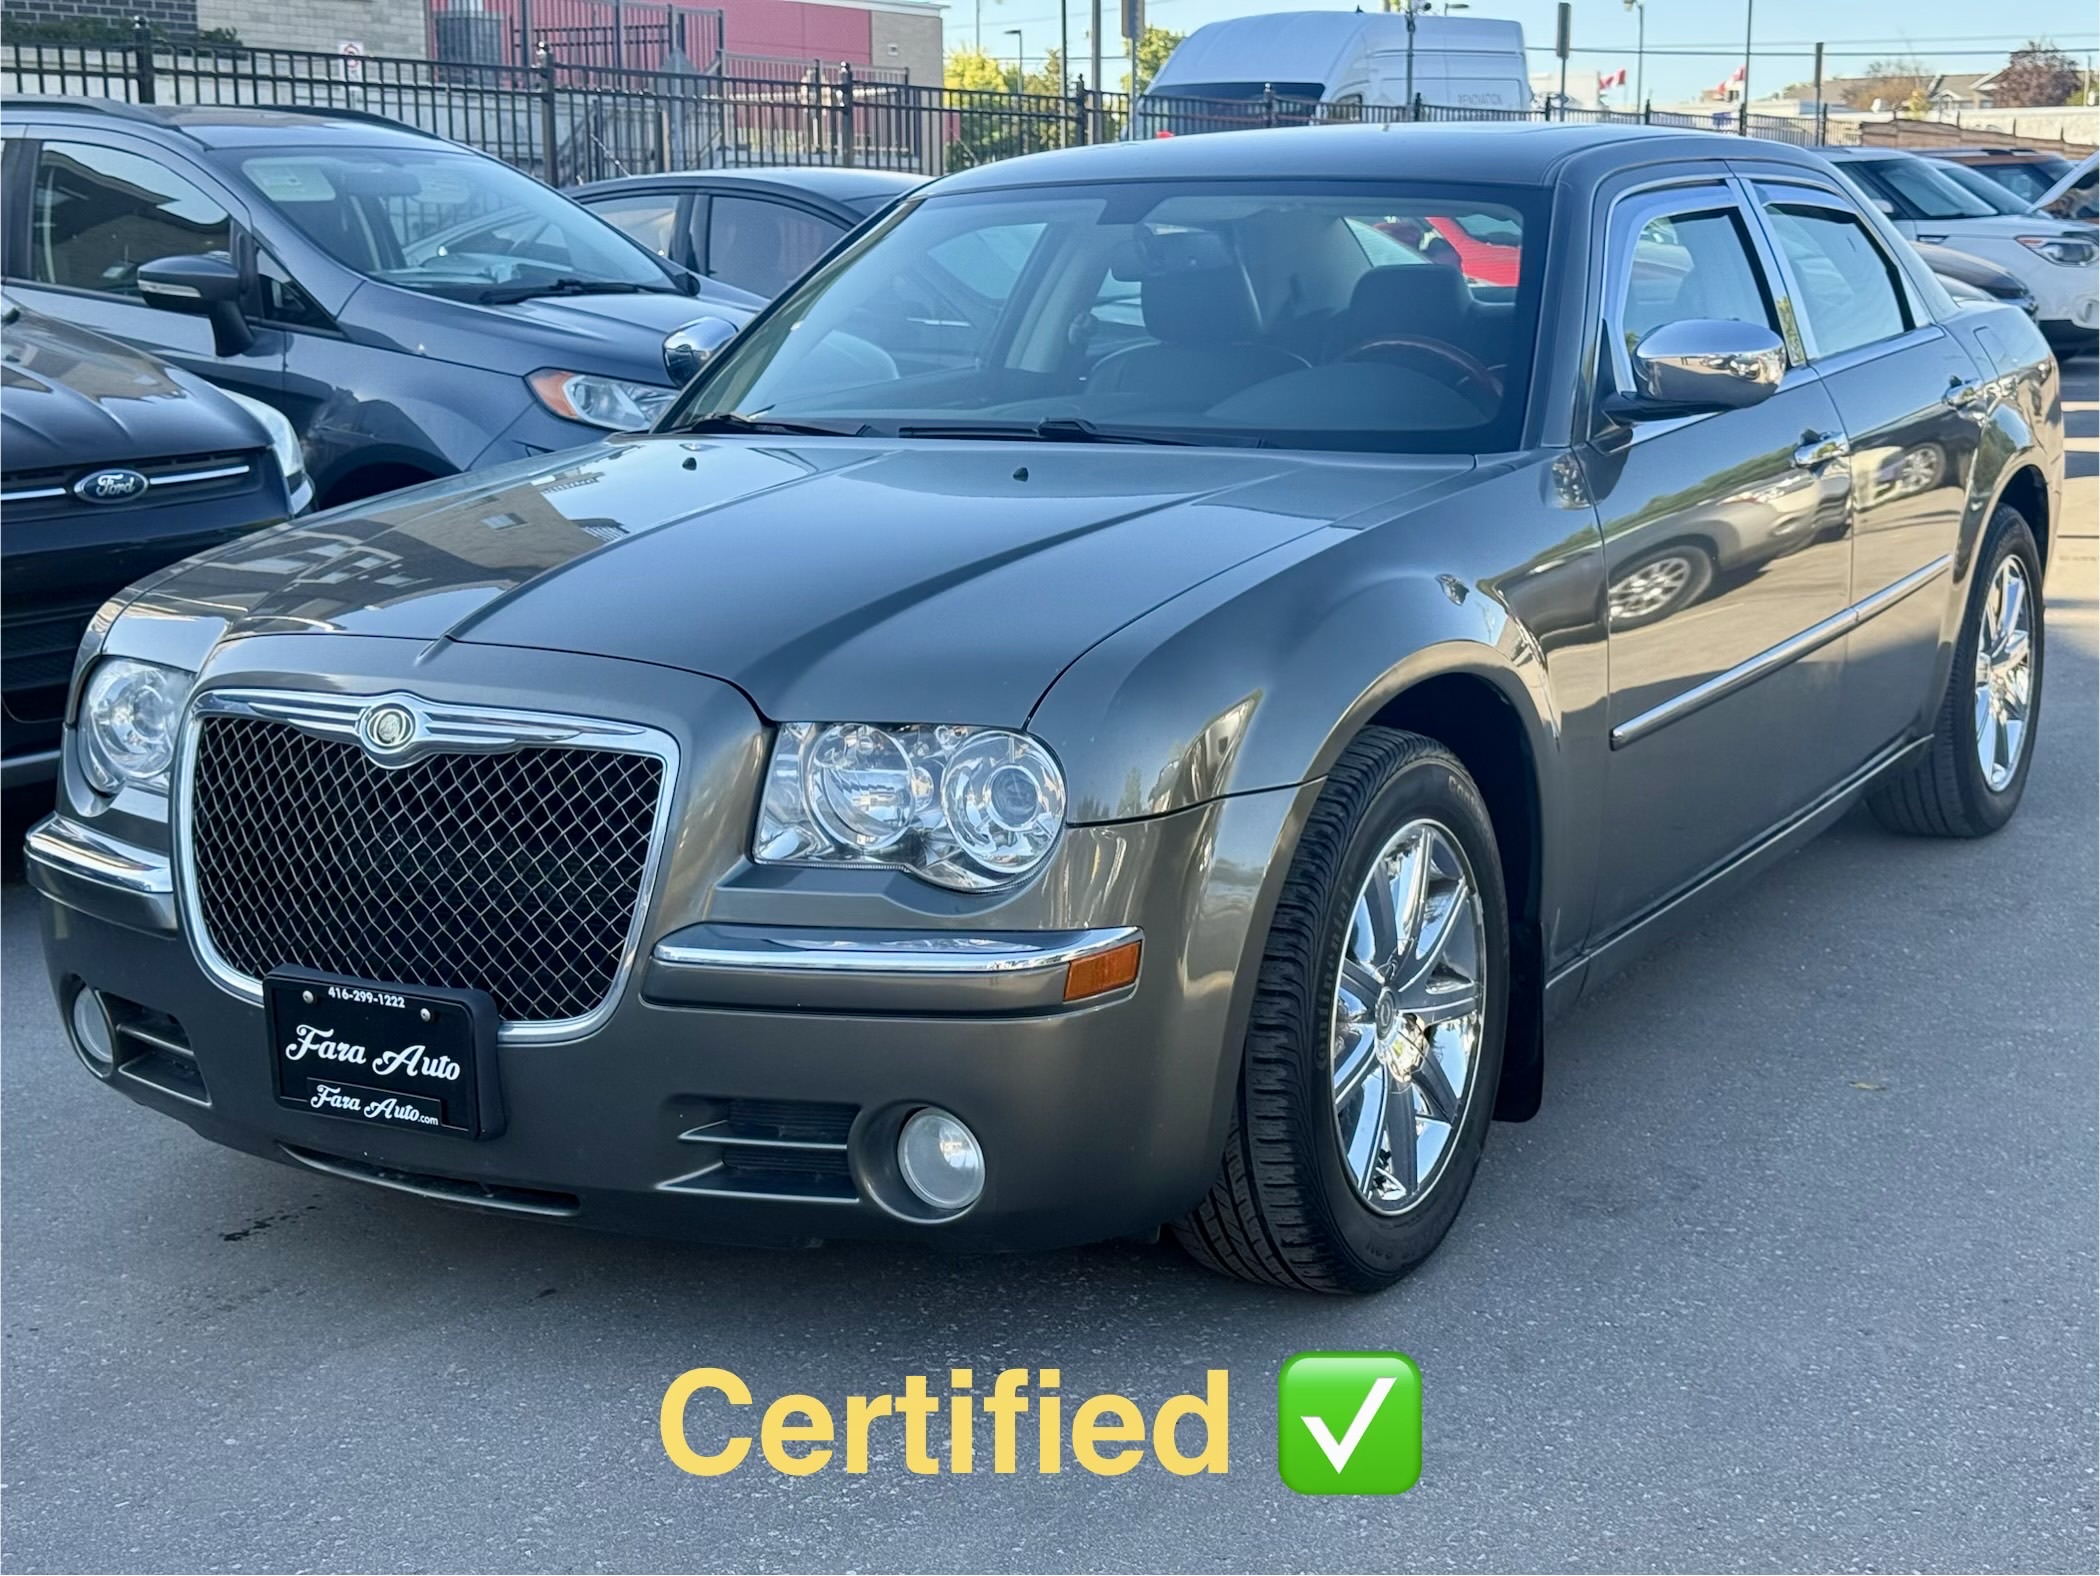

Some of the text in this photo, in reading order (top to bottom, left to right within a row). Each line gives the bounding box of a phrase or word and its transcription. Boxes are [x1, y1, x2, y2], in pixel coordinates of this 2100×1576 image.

[96, 473, 135, 497] Ford
[328, 986, 406, 1009] 416-299-1222
[285, 1024, 461, 1081] Fara Auto
[310, 1084, 439, 1126] Fara Auto.com
